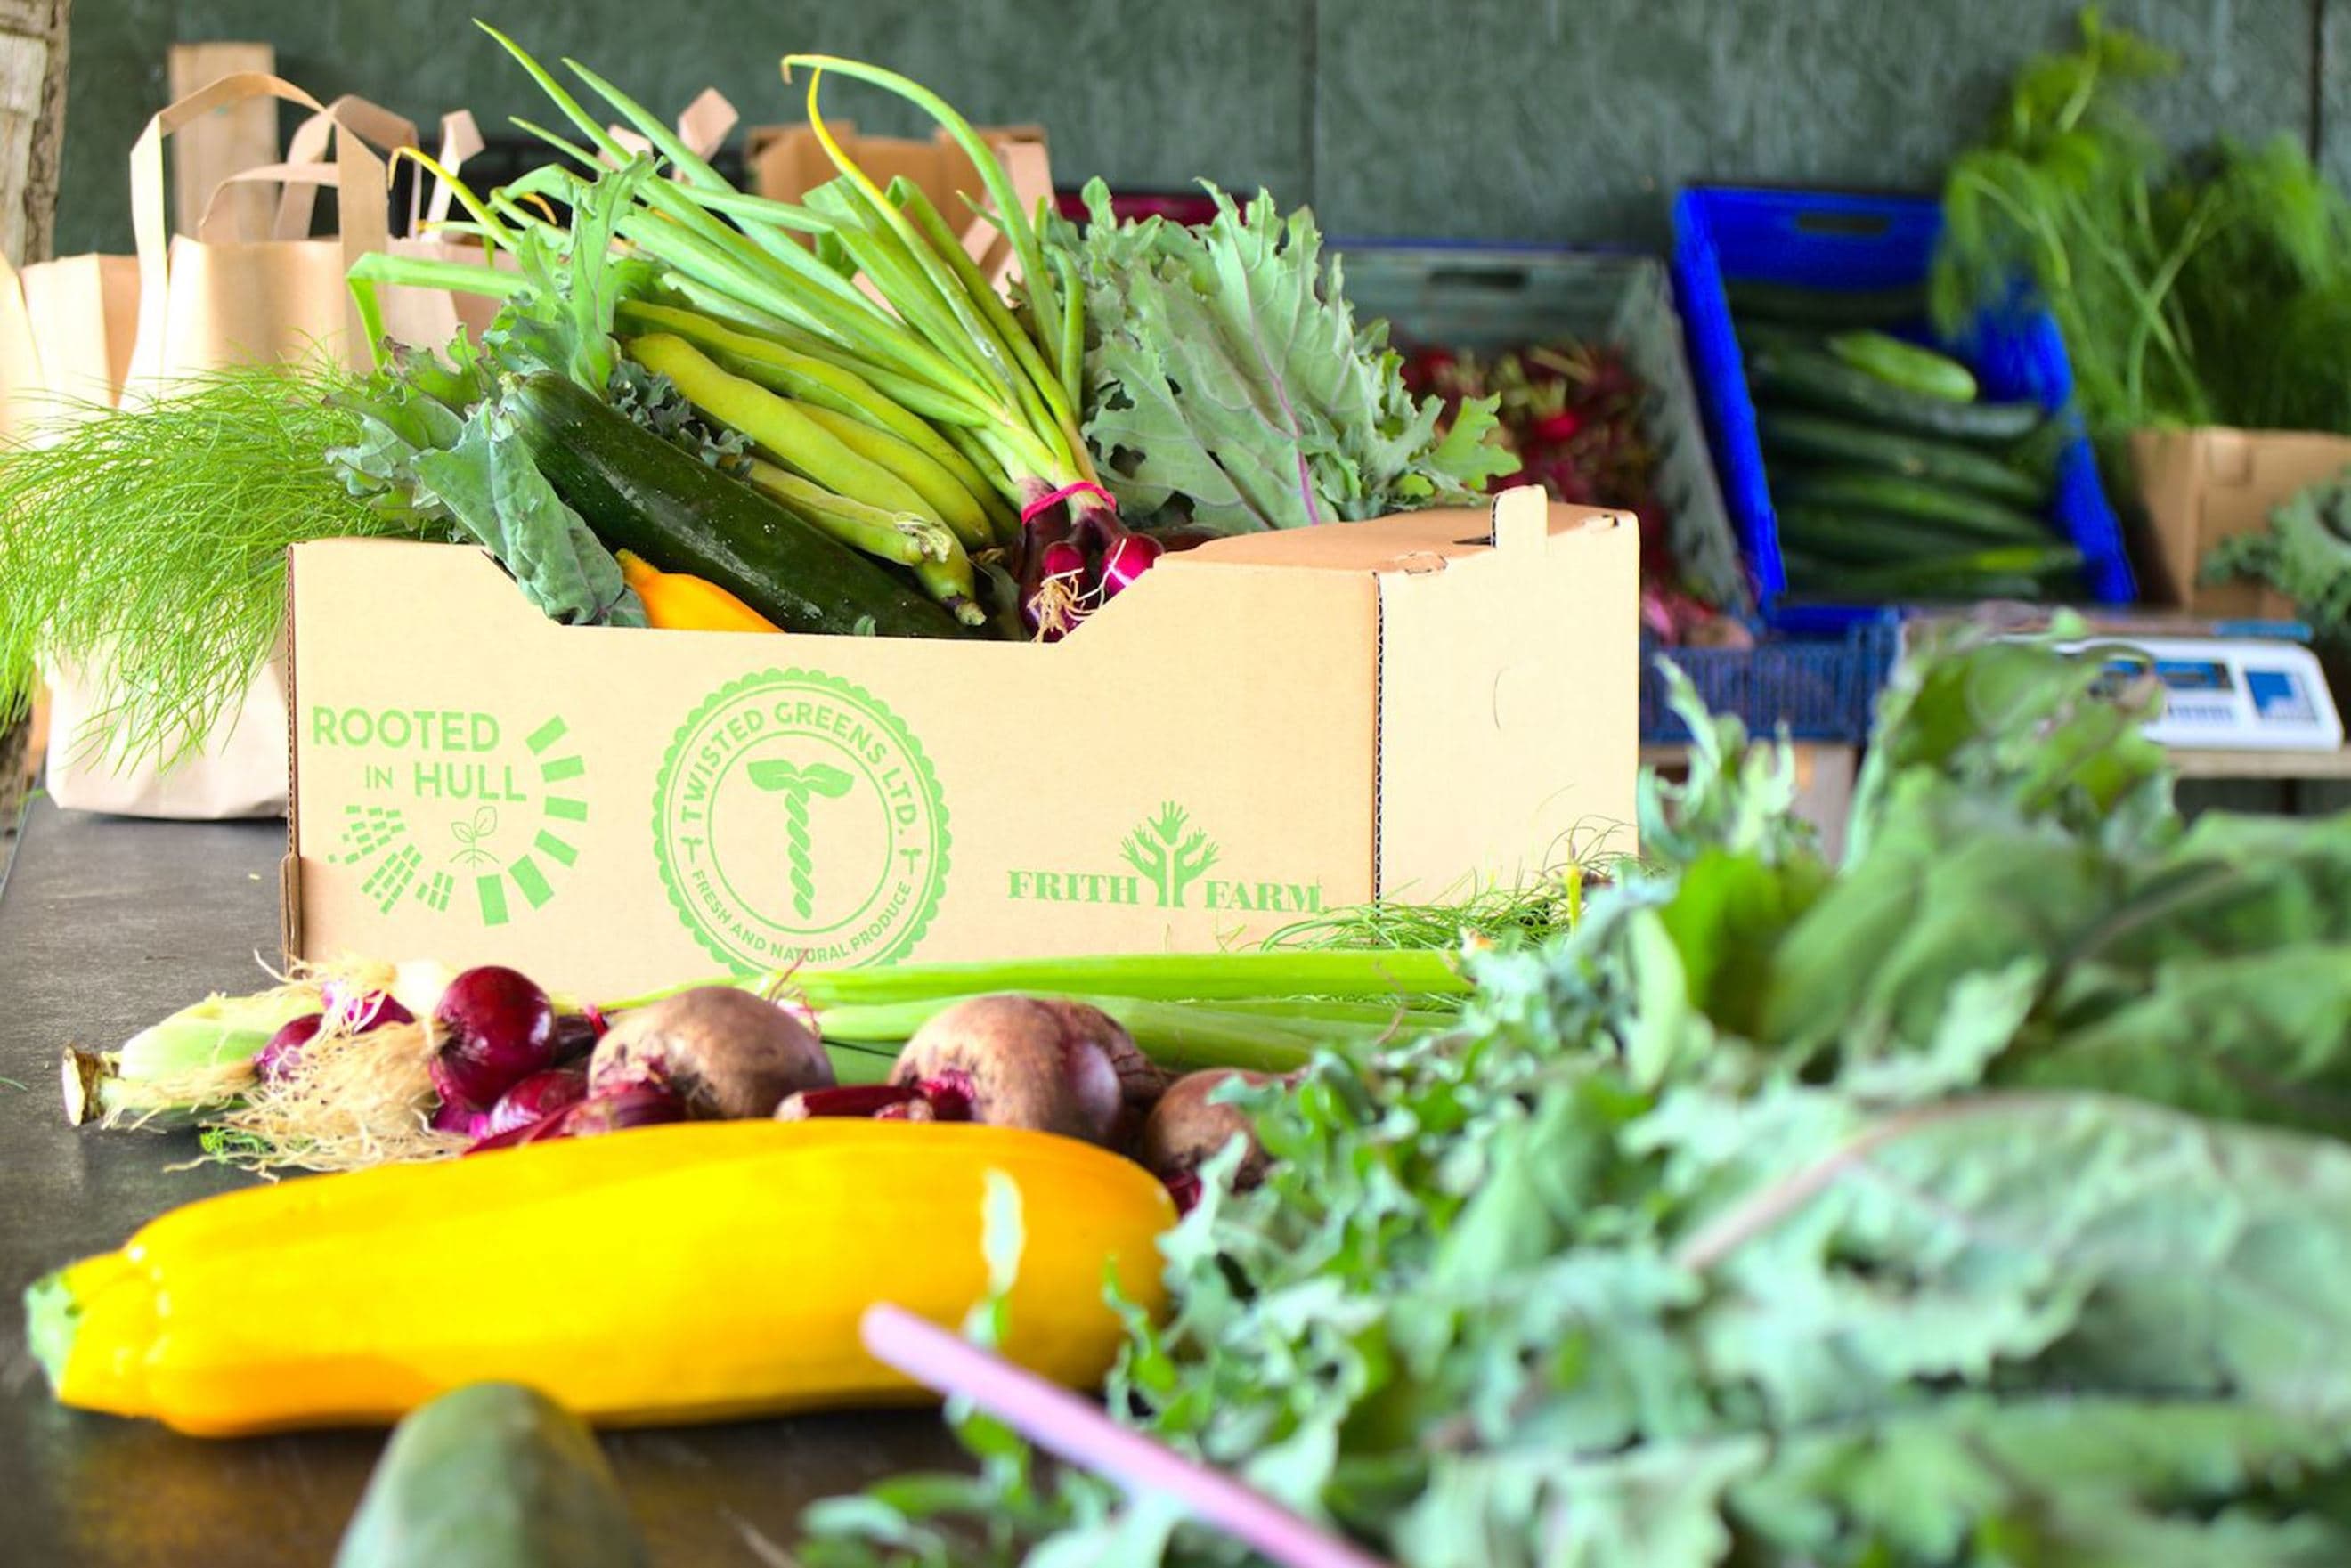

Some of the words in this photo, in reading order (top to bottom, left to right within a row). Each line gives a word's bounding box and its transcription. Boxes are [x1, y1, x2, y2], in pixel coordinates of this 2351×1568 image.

[313, 706, 500, 752] ROOTED
[365, 765, 393, 789] IN
[414, 761, 528, 801] HULL
[681, 709, 764, 823] TWISTED
[774, 702, 888, 764] GREENS
[883, 768, 917, 835] LTD.
[1007, 870, 1140, 906] FRITH
[1204, 880, 1322, 914] FARM
[692, 869, 732, 924] FRESH
[729, 923, 767, 951] AND
[770, 943, 850, 963] NATURAL
[850, 881, 912, 951] PRODUCE
